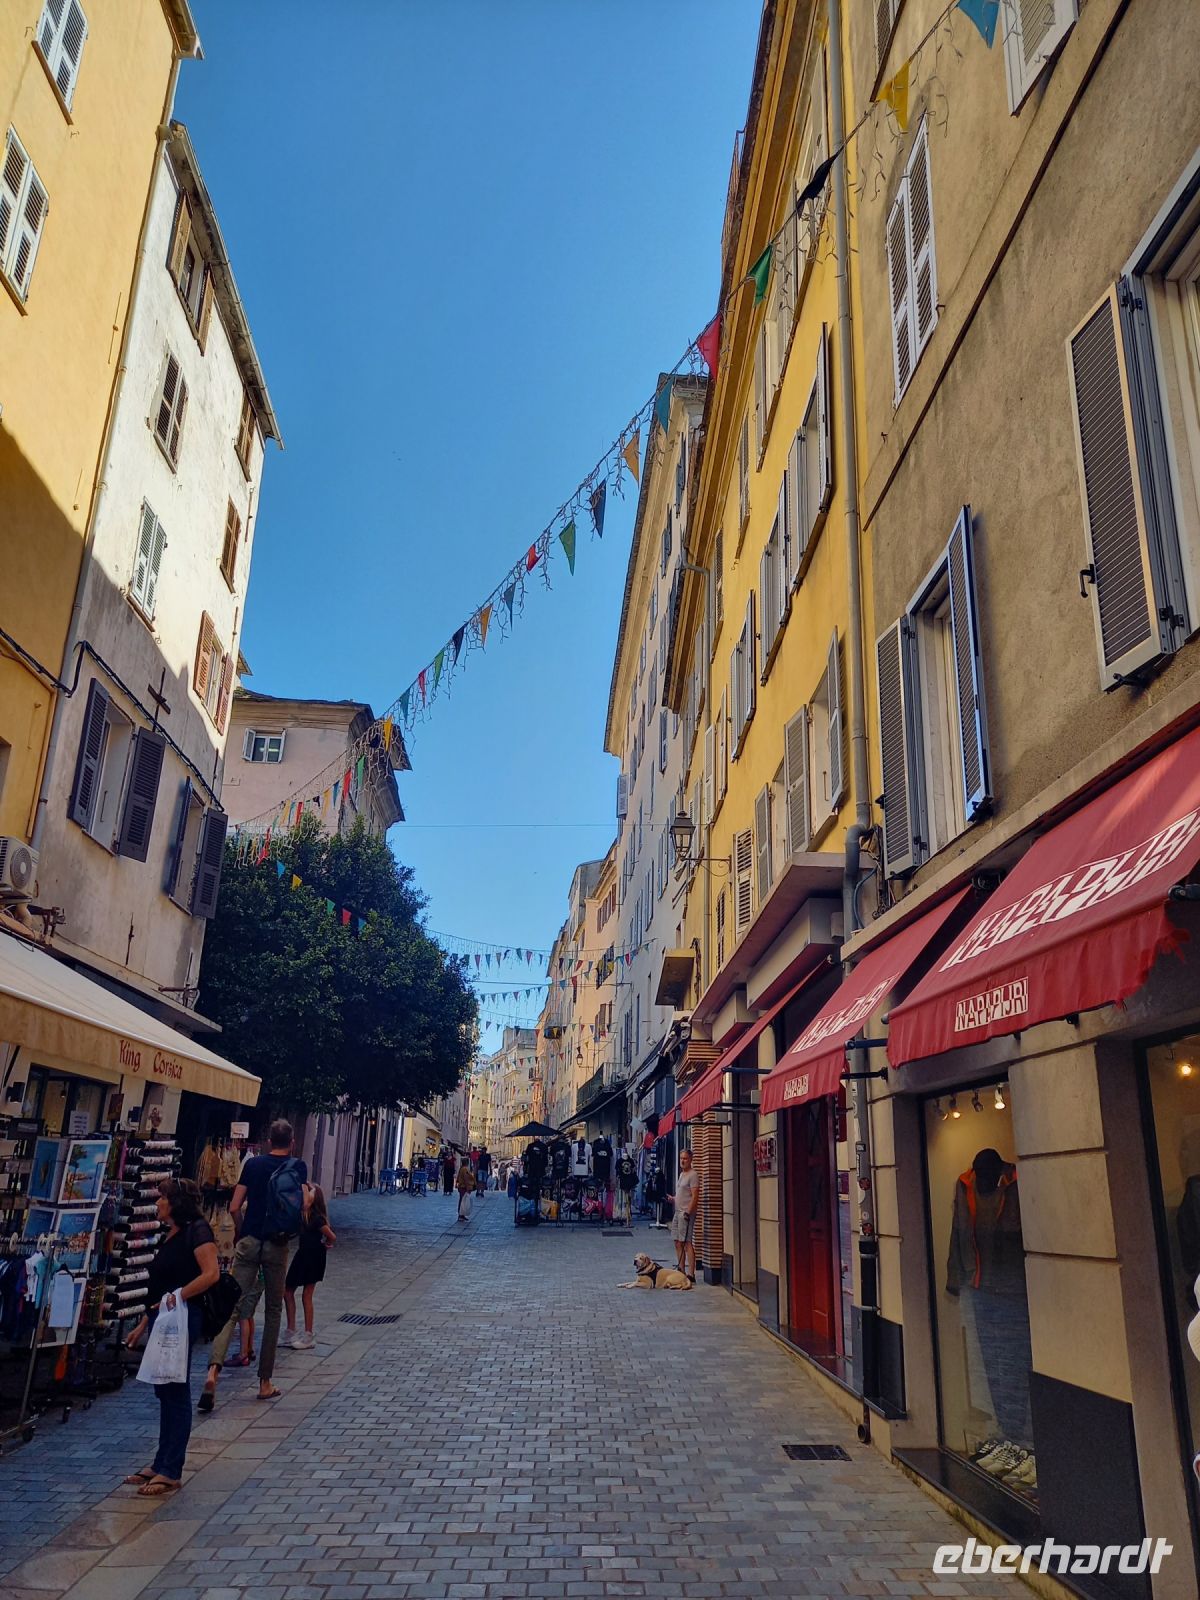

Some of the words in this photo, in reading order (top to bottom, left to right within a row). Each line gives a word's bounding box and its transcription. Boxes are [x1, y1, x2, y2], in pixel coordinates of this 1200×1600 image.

[955, 977, 1029, 1032] NAPAPIJRI
[119, 1039, 142, 1073] King
[153, 1051, 183, 1080] Corsica
